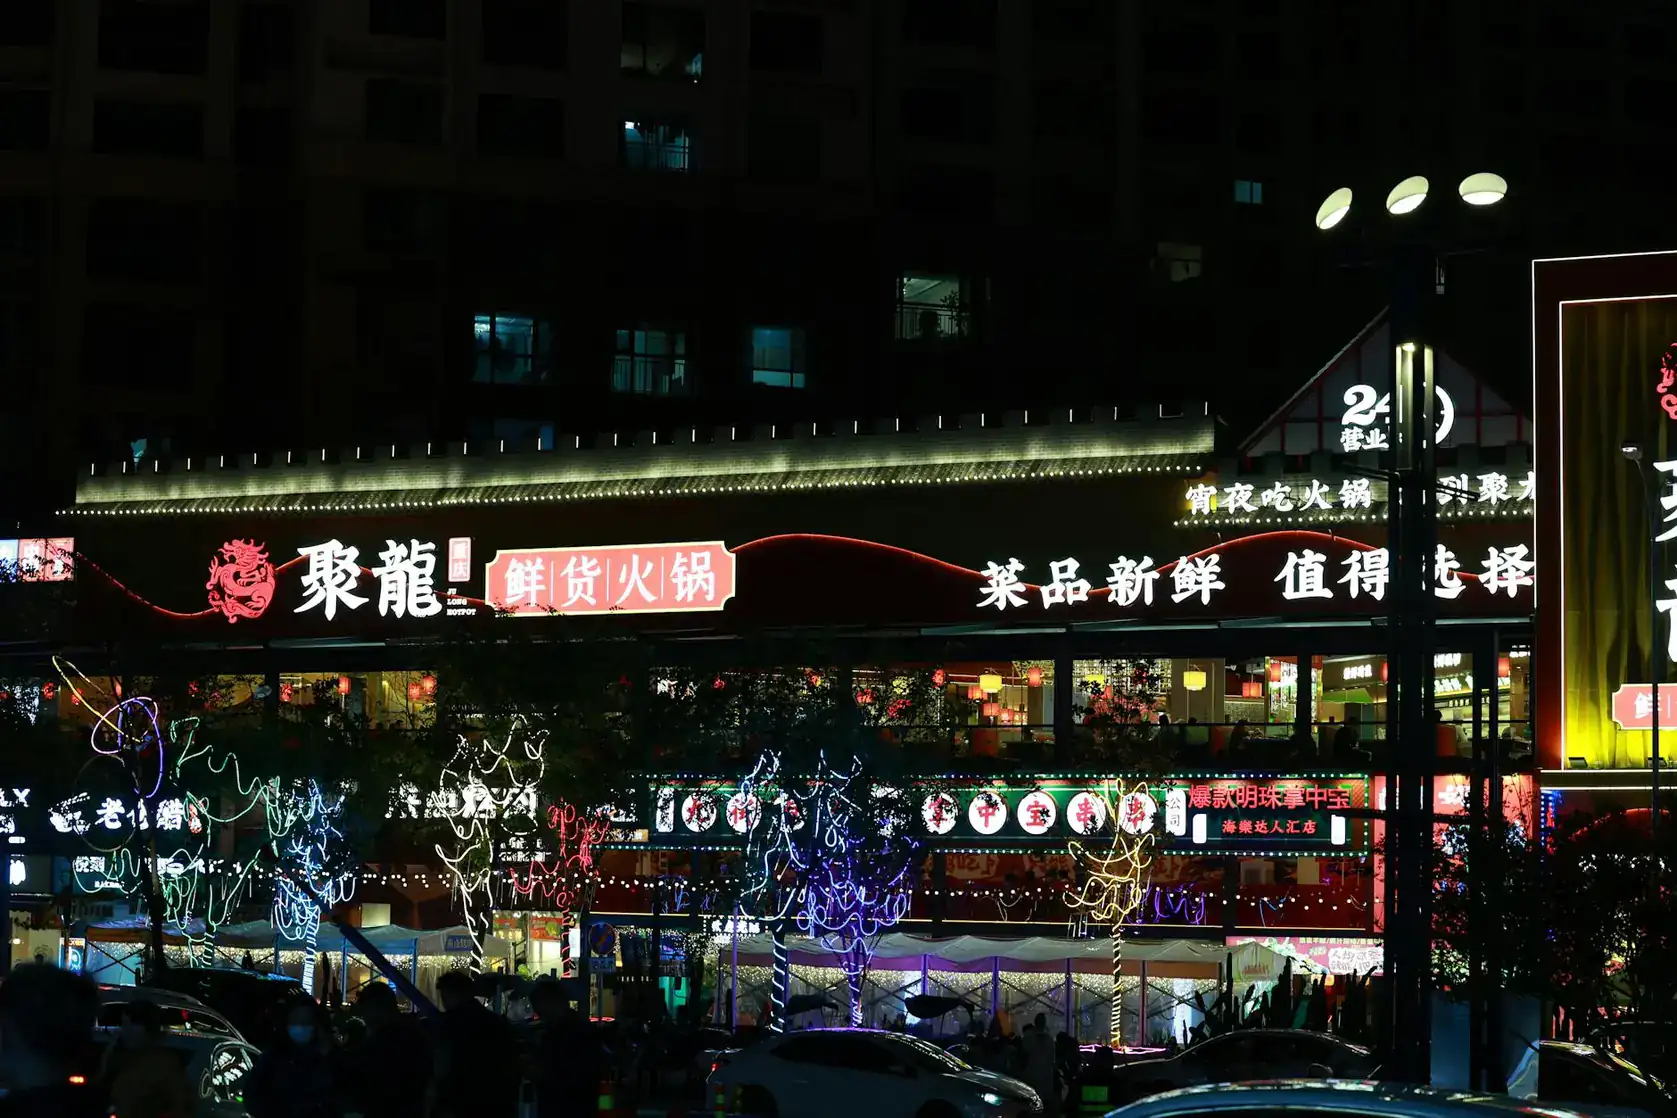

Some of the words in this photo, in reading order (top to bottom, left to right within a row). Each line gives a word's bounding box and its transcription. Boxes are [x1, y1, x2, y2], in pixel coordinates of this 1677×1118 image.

[1185, 478, 1373, 515] 宵夜吃火锅
[293, 538, 443, 621] 聚龍
[447, 588, 457, 596] JU
[504, 550, 716, 608] 鲜货火锅
[976, 554, 1226, 611] 菜品新鲜
[446, 608, 477, 616] HOTPOT
[447, 598, 468, 606] LONG
[1188, 784, 1351, 810] 爆款明珠掌中宝
